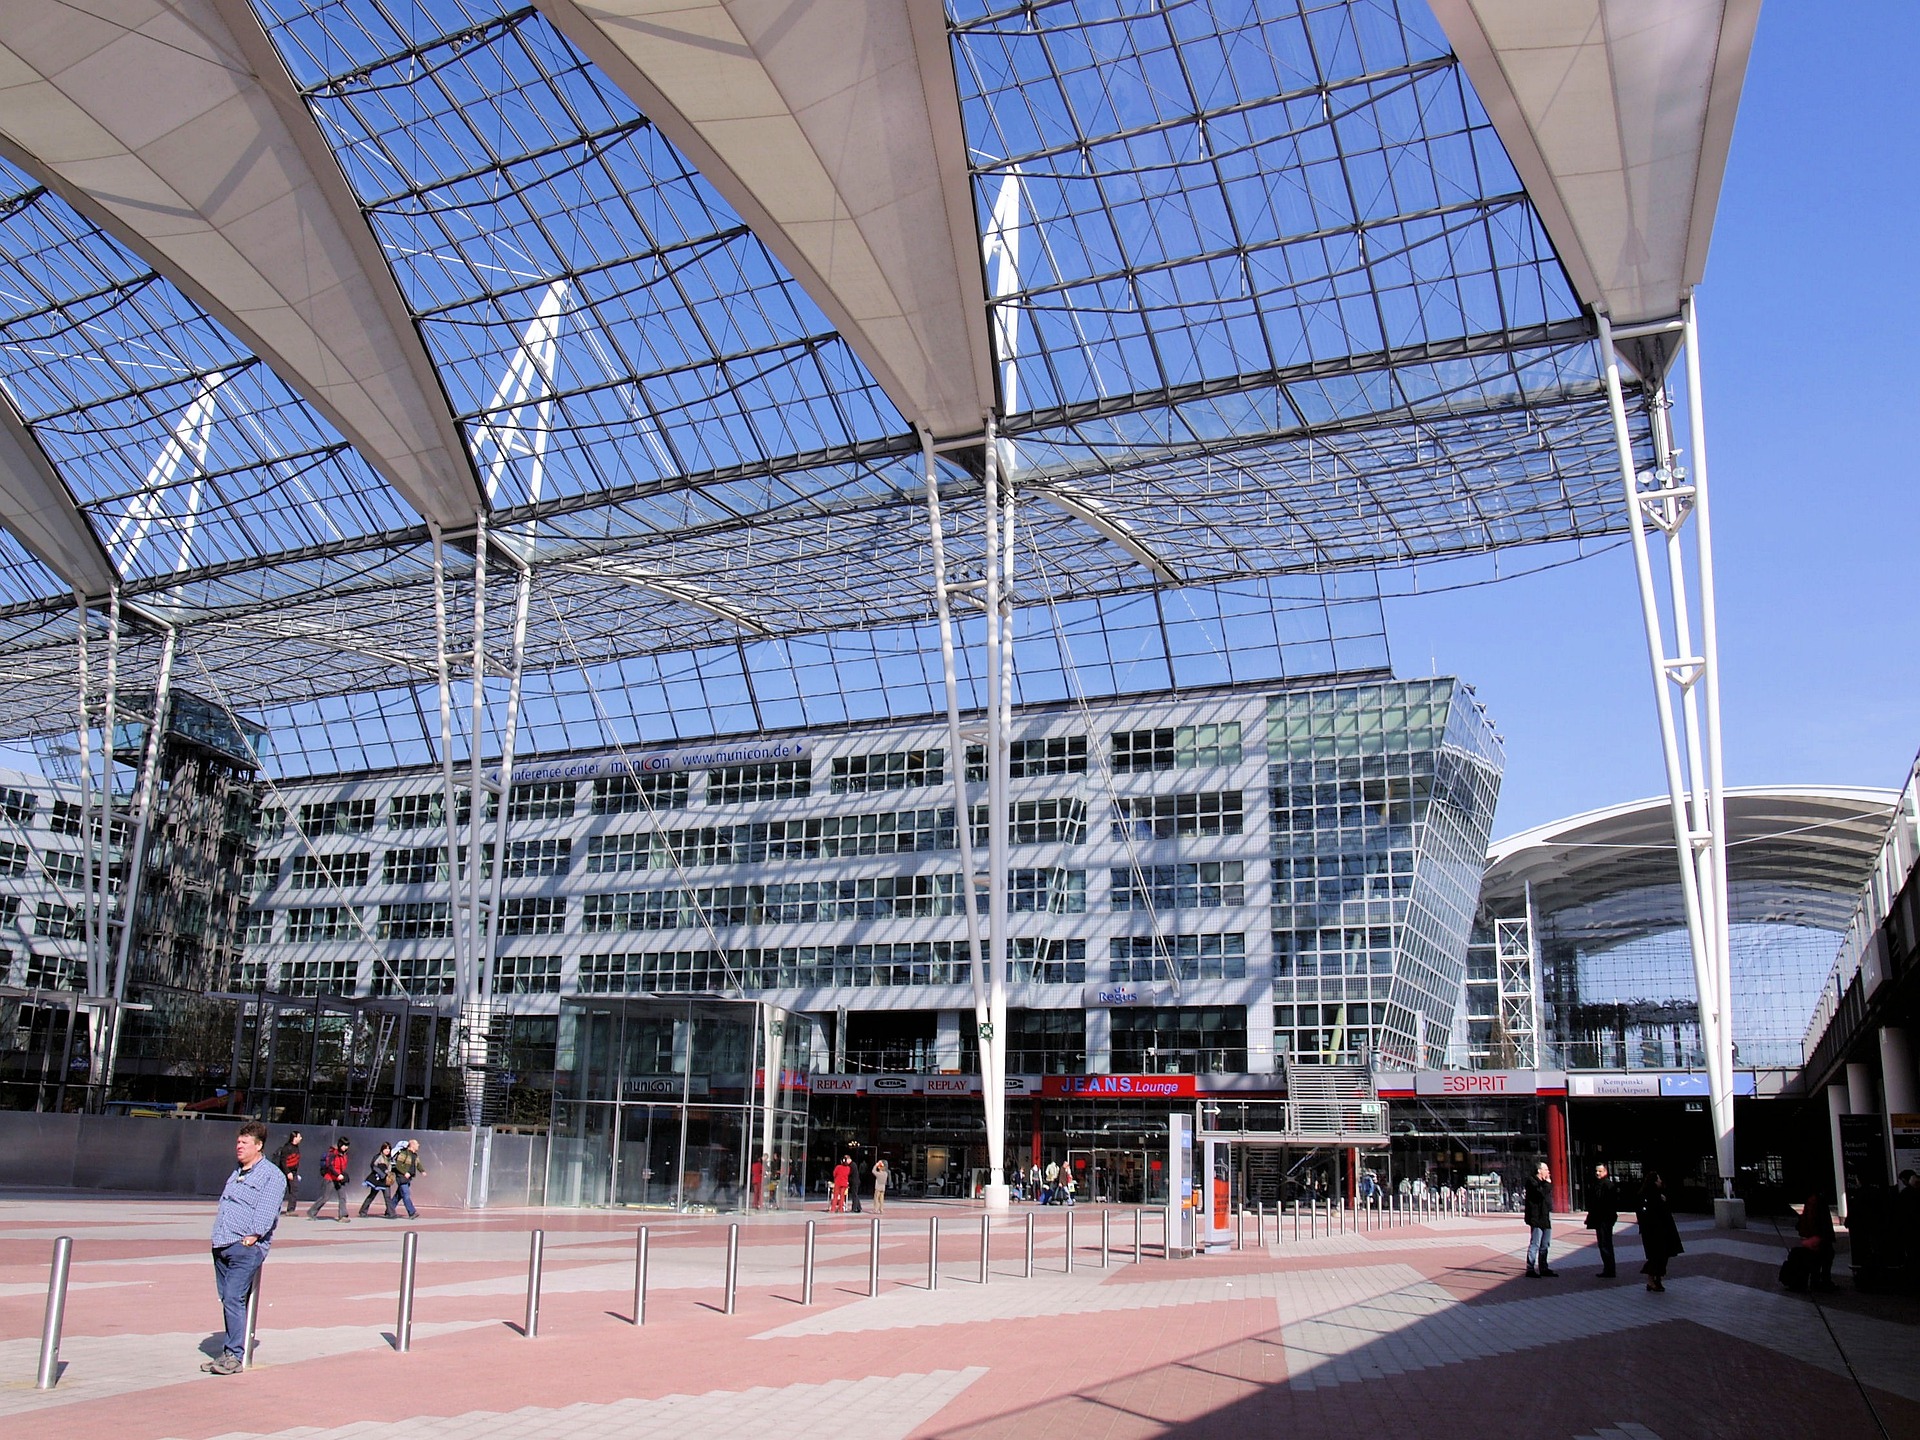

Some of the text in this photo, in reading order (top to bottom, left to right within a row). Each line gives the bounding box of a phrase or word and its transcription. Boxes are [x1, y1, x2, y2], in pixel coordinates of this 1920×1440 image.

[564, 763, 600, 777] center
[682, 744, 789, 766] www.municon.de
[1099, 991, 1138, 1005] Regus
[816, 1080, 853, 1090] REPLAY
[928, 1080, 967, 1091] REPLAY
[1135, 1081, 1179, 1094] Lounge
[1443, 1076, 1508, 1091] ESPRIT
[1603, 1078, 1644, 1087] Kempinski
[1597, 1086, 1650, 1095] Hotel Airport
